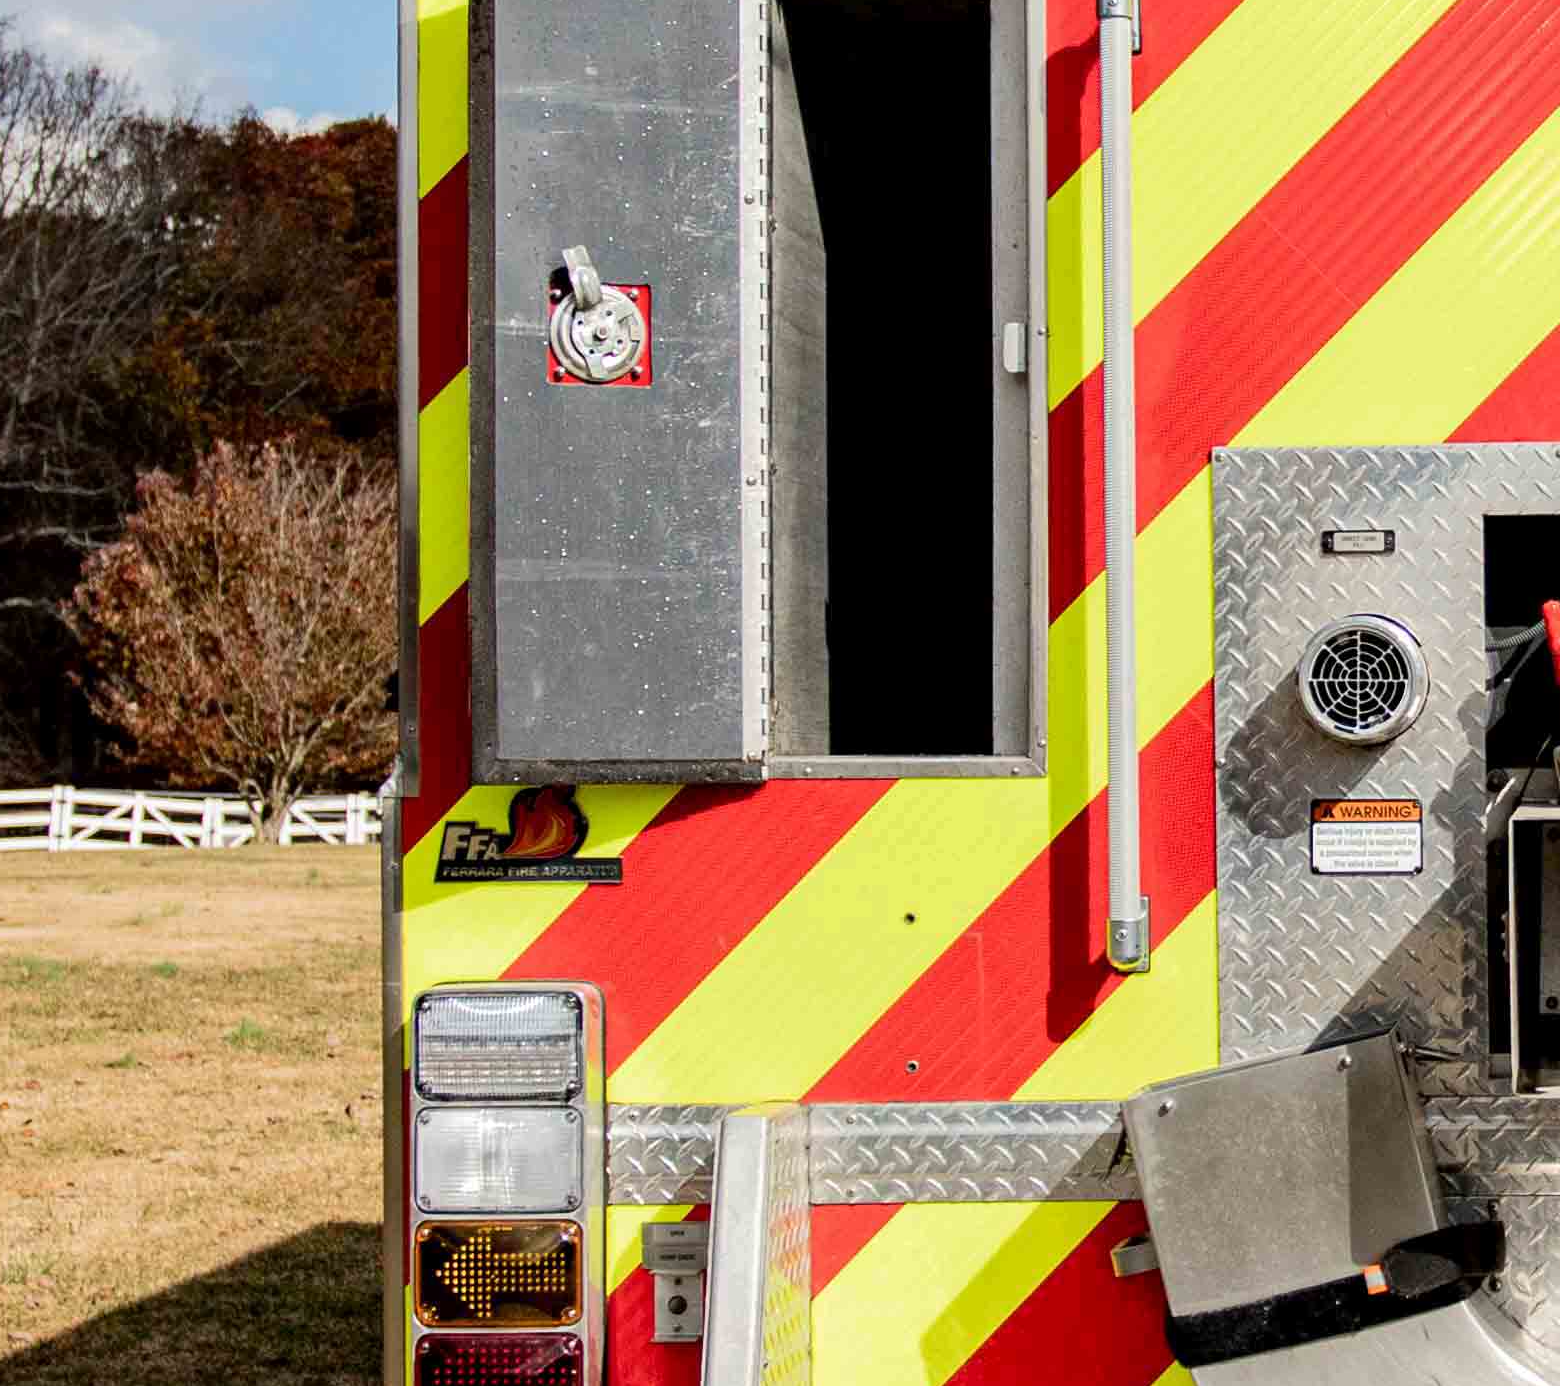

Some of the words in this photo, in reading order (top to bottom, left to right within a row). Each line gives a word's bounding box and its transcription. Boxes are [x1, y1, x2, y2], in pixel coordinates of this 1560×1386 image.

[1339, 805, 1412, 819] WARNING
[441, 824, 501, 861] FFA
[442, 865, 505, 877] FERRARA
[507, 865, 539, 877] FIRE
